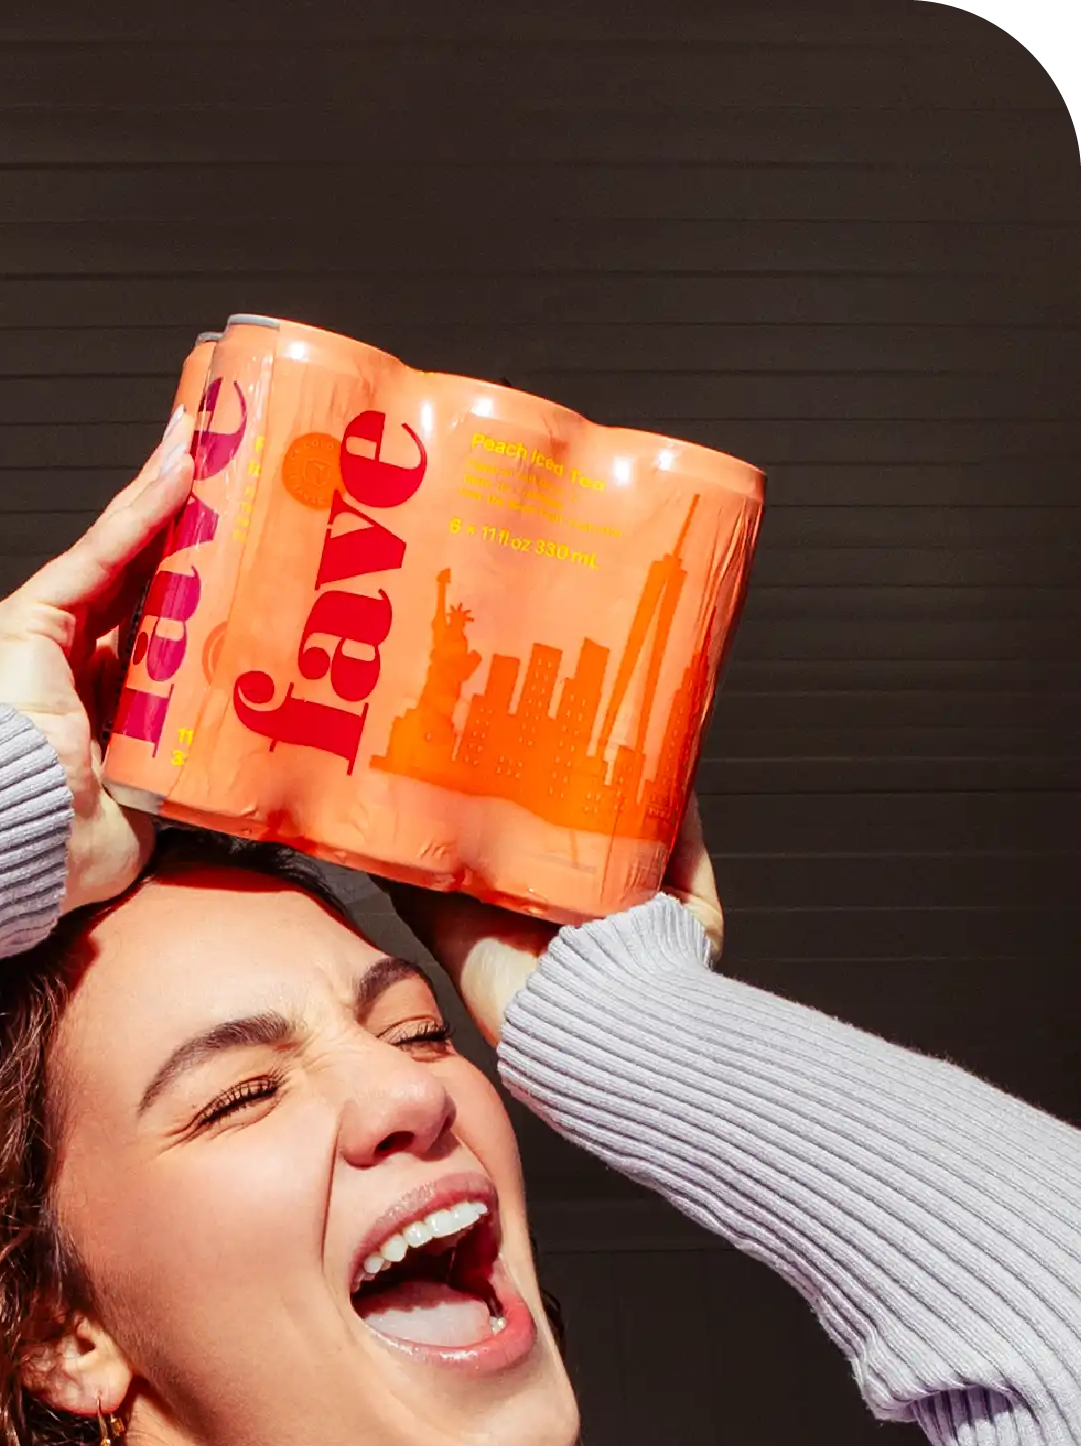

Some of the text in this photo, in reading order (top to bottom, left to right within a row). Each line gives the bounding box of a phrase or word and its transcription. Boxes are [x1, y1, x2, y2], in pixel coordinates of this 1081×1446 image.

[471, 432, 527, 463] Peach
[530, 449, 564, 477] Iced
[570, 468, 606, 492] Tea
[449, 517, 462, 534] 6
[482, 525, 497, 542] 11
[510, 537, 530, 552] oz
[534, 538, 570, 561] 330
[571, 551, 600, 570] mL
[232, 409, 427, 776] fave
